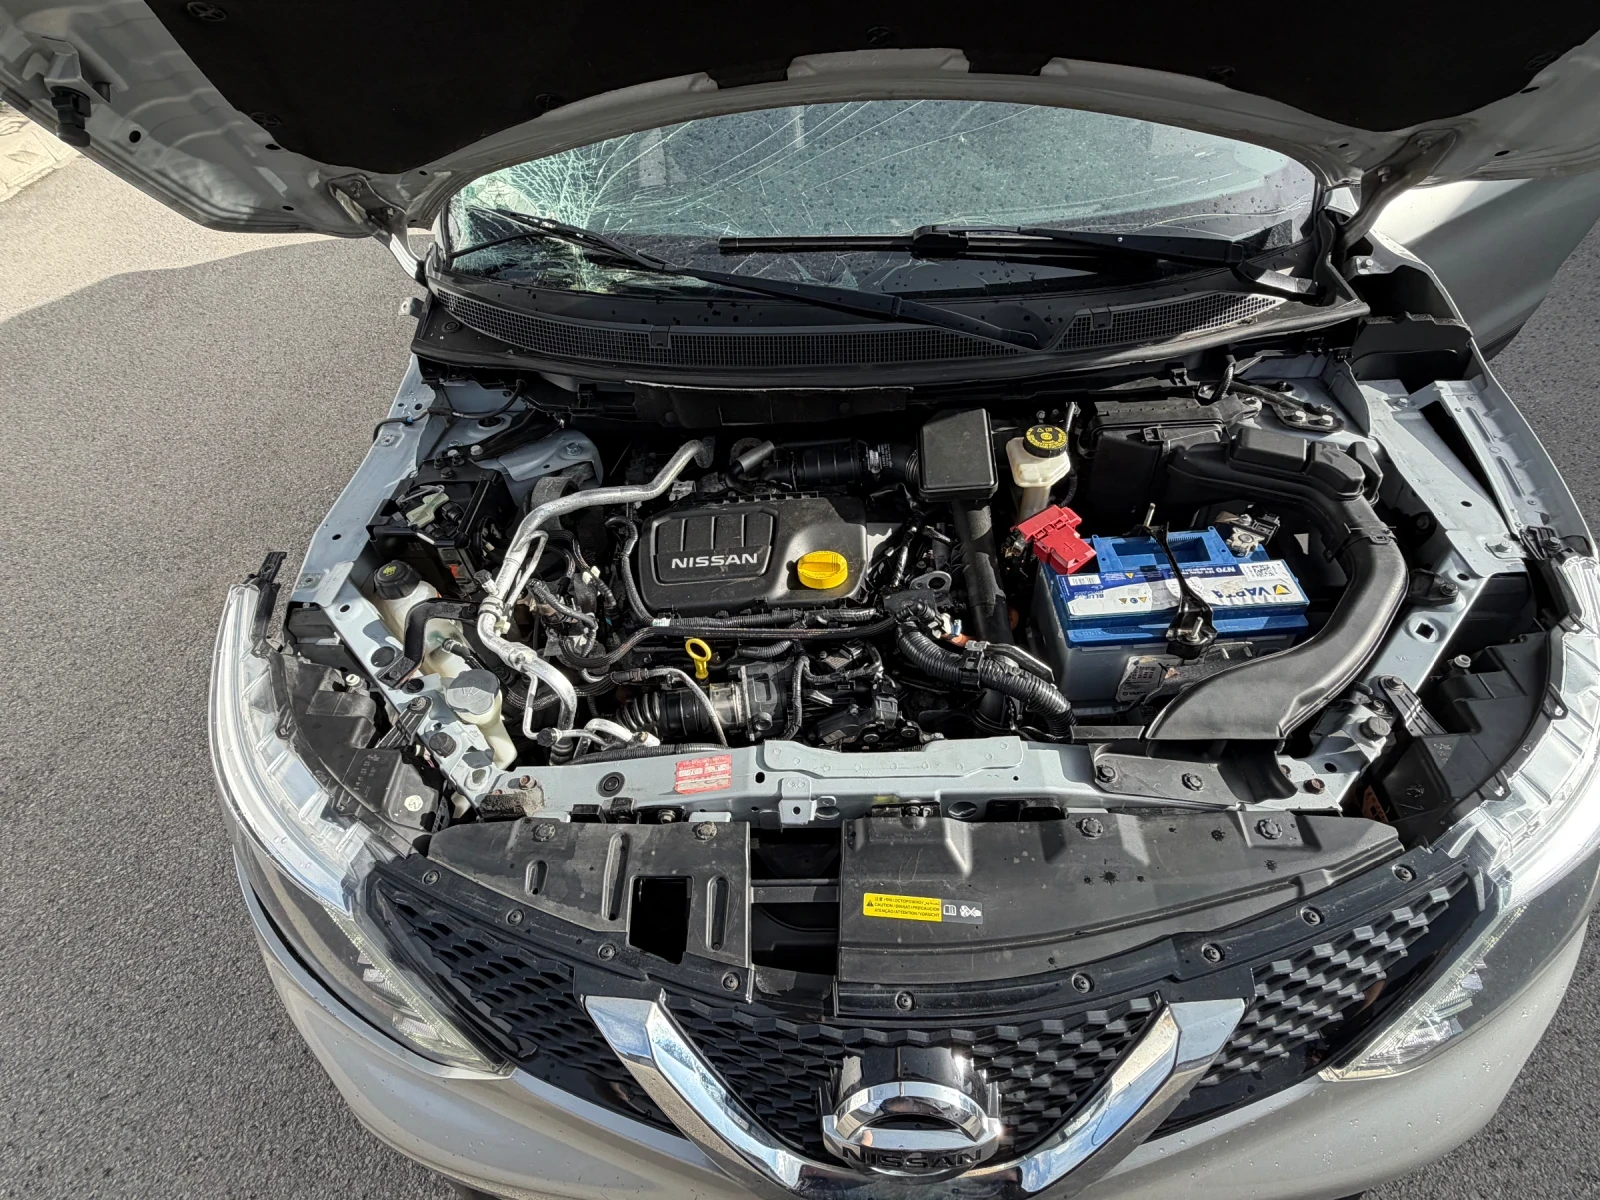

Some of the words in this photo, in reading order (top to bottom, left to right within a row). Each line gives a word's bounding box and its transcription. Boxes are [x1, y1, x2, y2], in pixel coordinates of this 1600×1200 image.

[671, 553, 758, 569] NISSAN
[1215, 565, 1236, 573] N70
[842, 1145, 982, 1169] NISSAN
